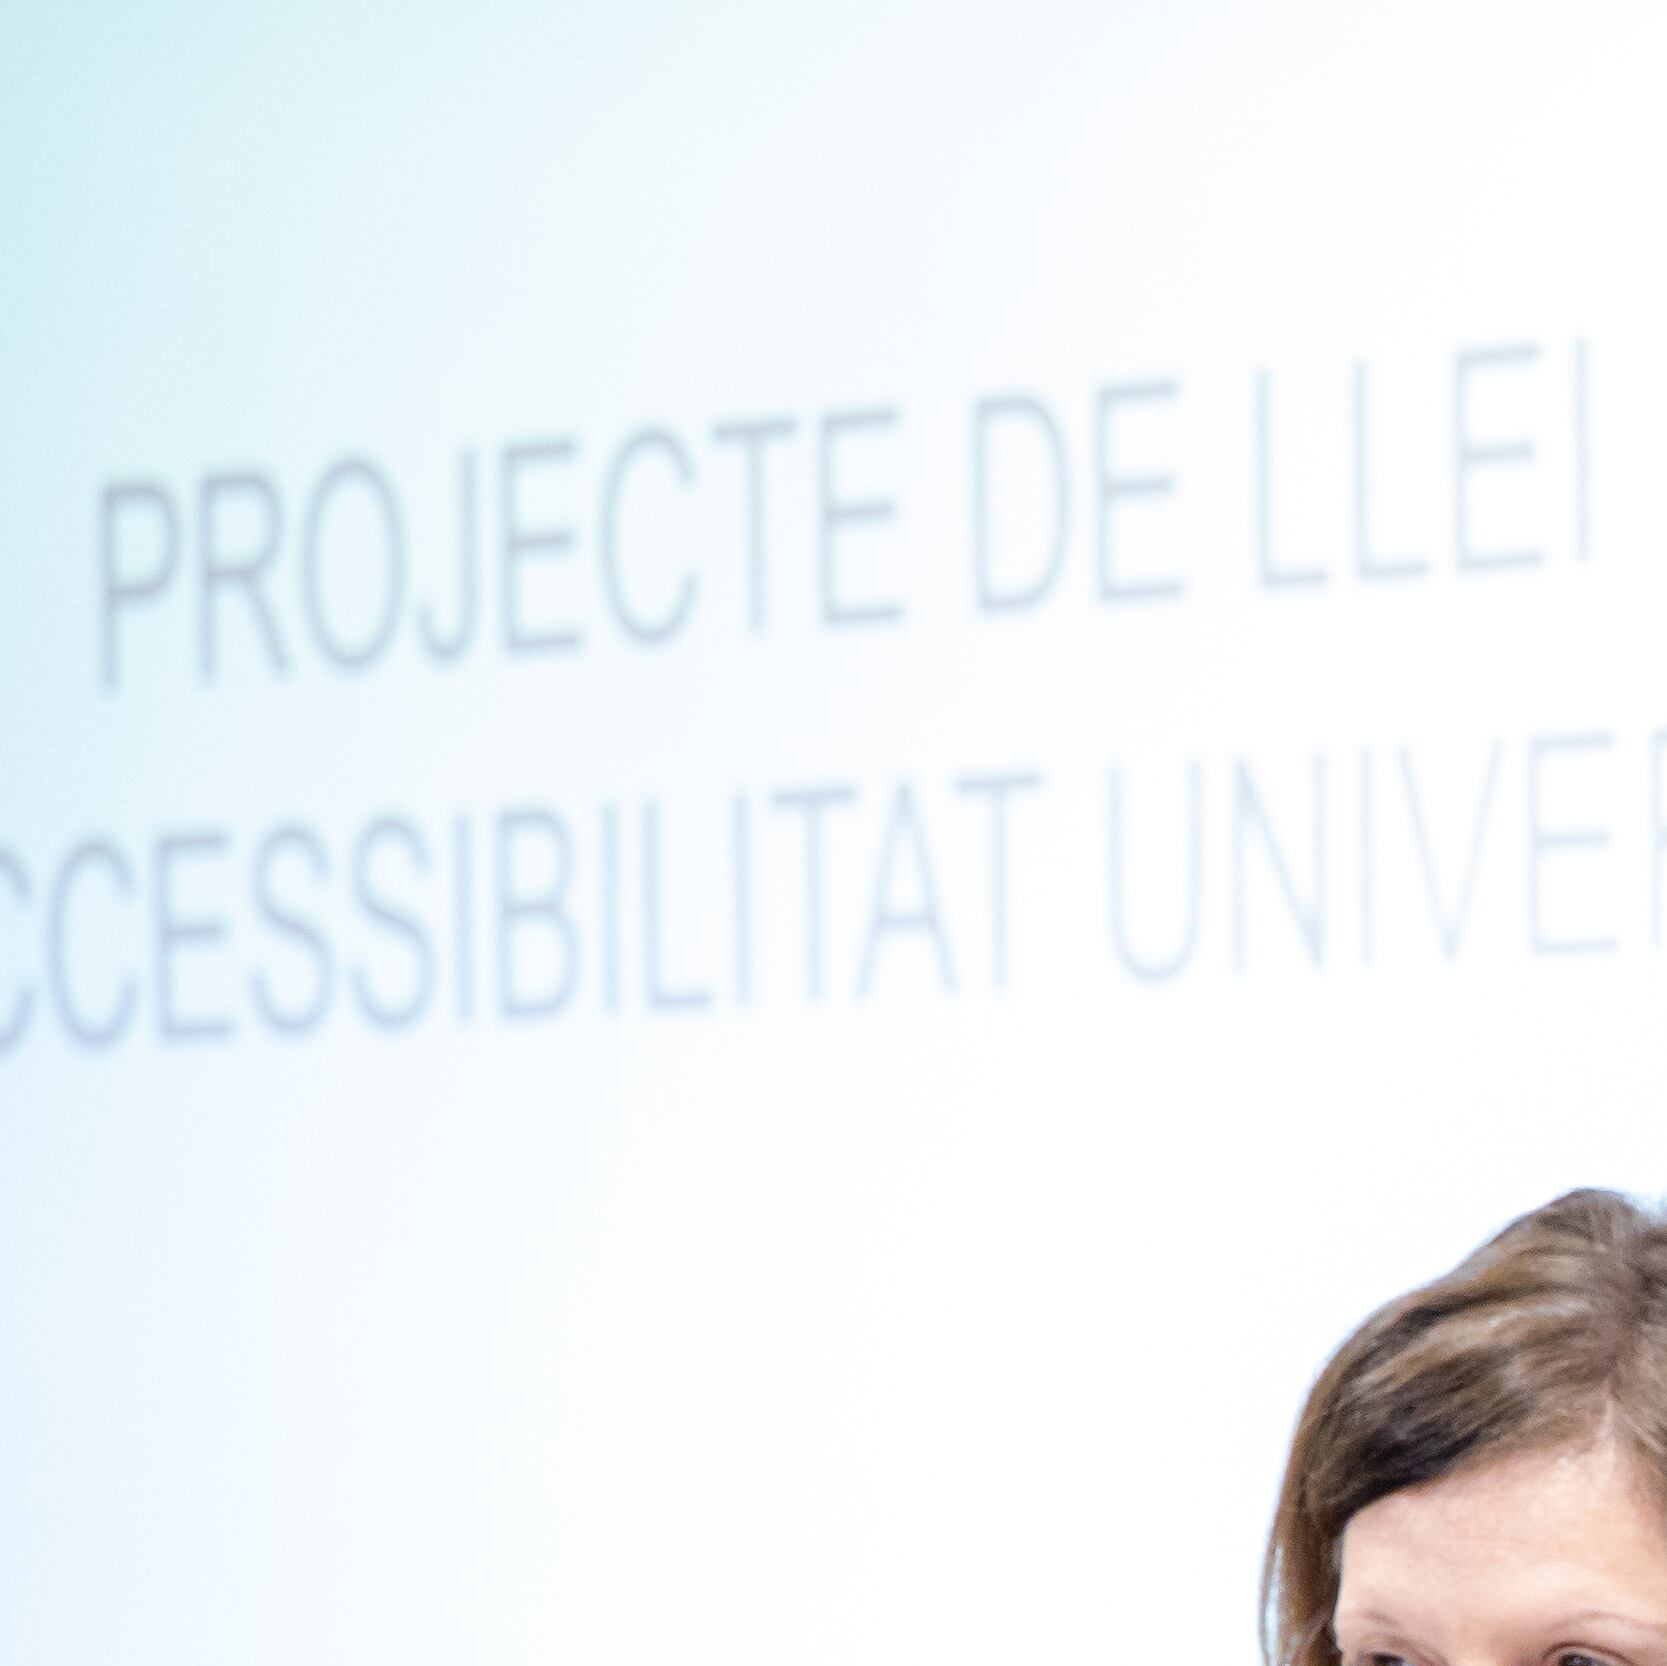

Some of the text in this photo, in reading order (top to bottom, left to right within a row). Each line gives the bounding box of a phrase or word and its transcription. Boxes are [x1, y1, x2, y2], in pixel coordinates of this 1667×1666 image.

[98, 336, 1592, 698] PROJECTE DE LLEI
